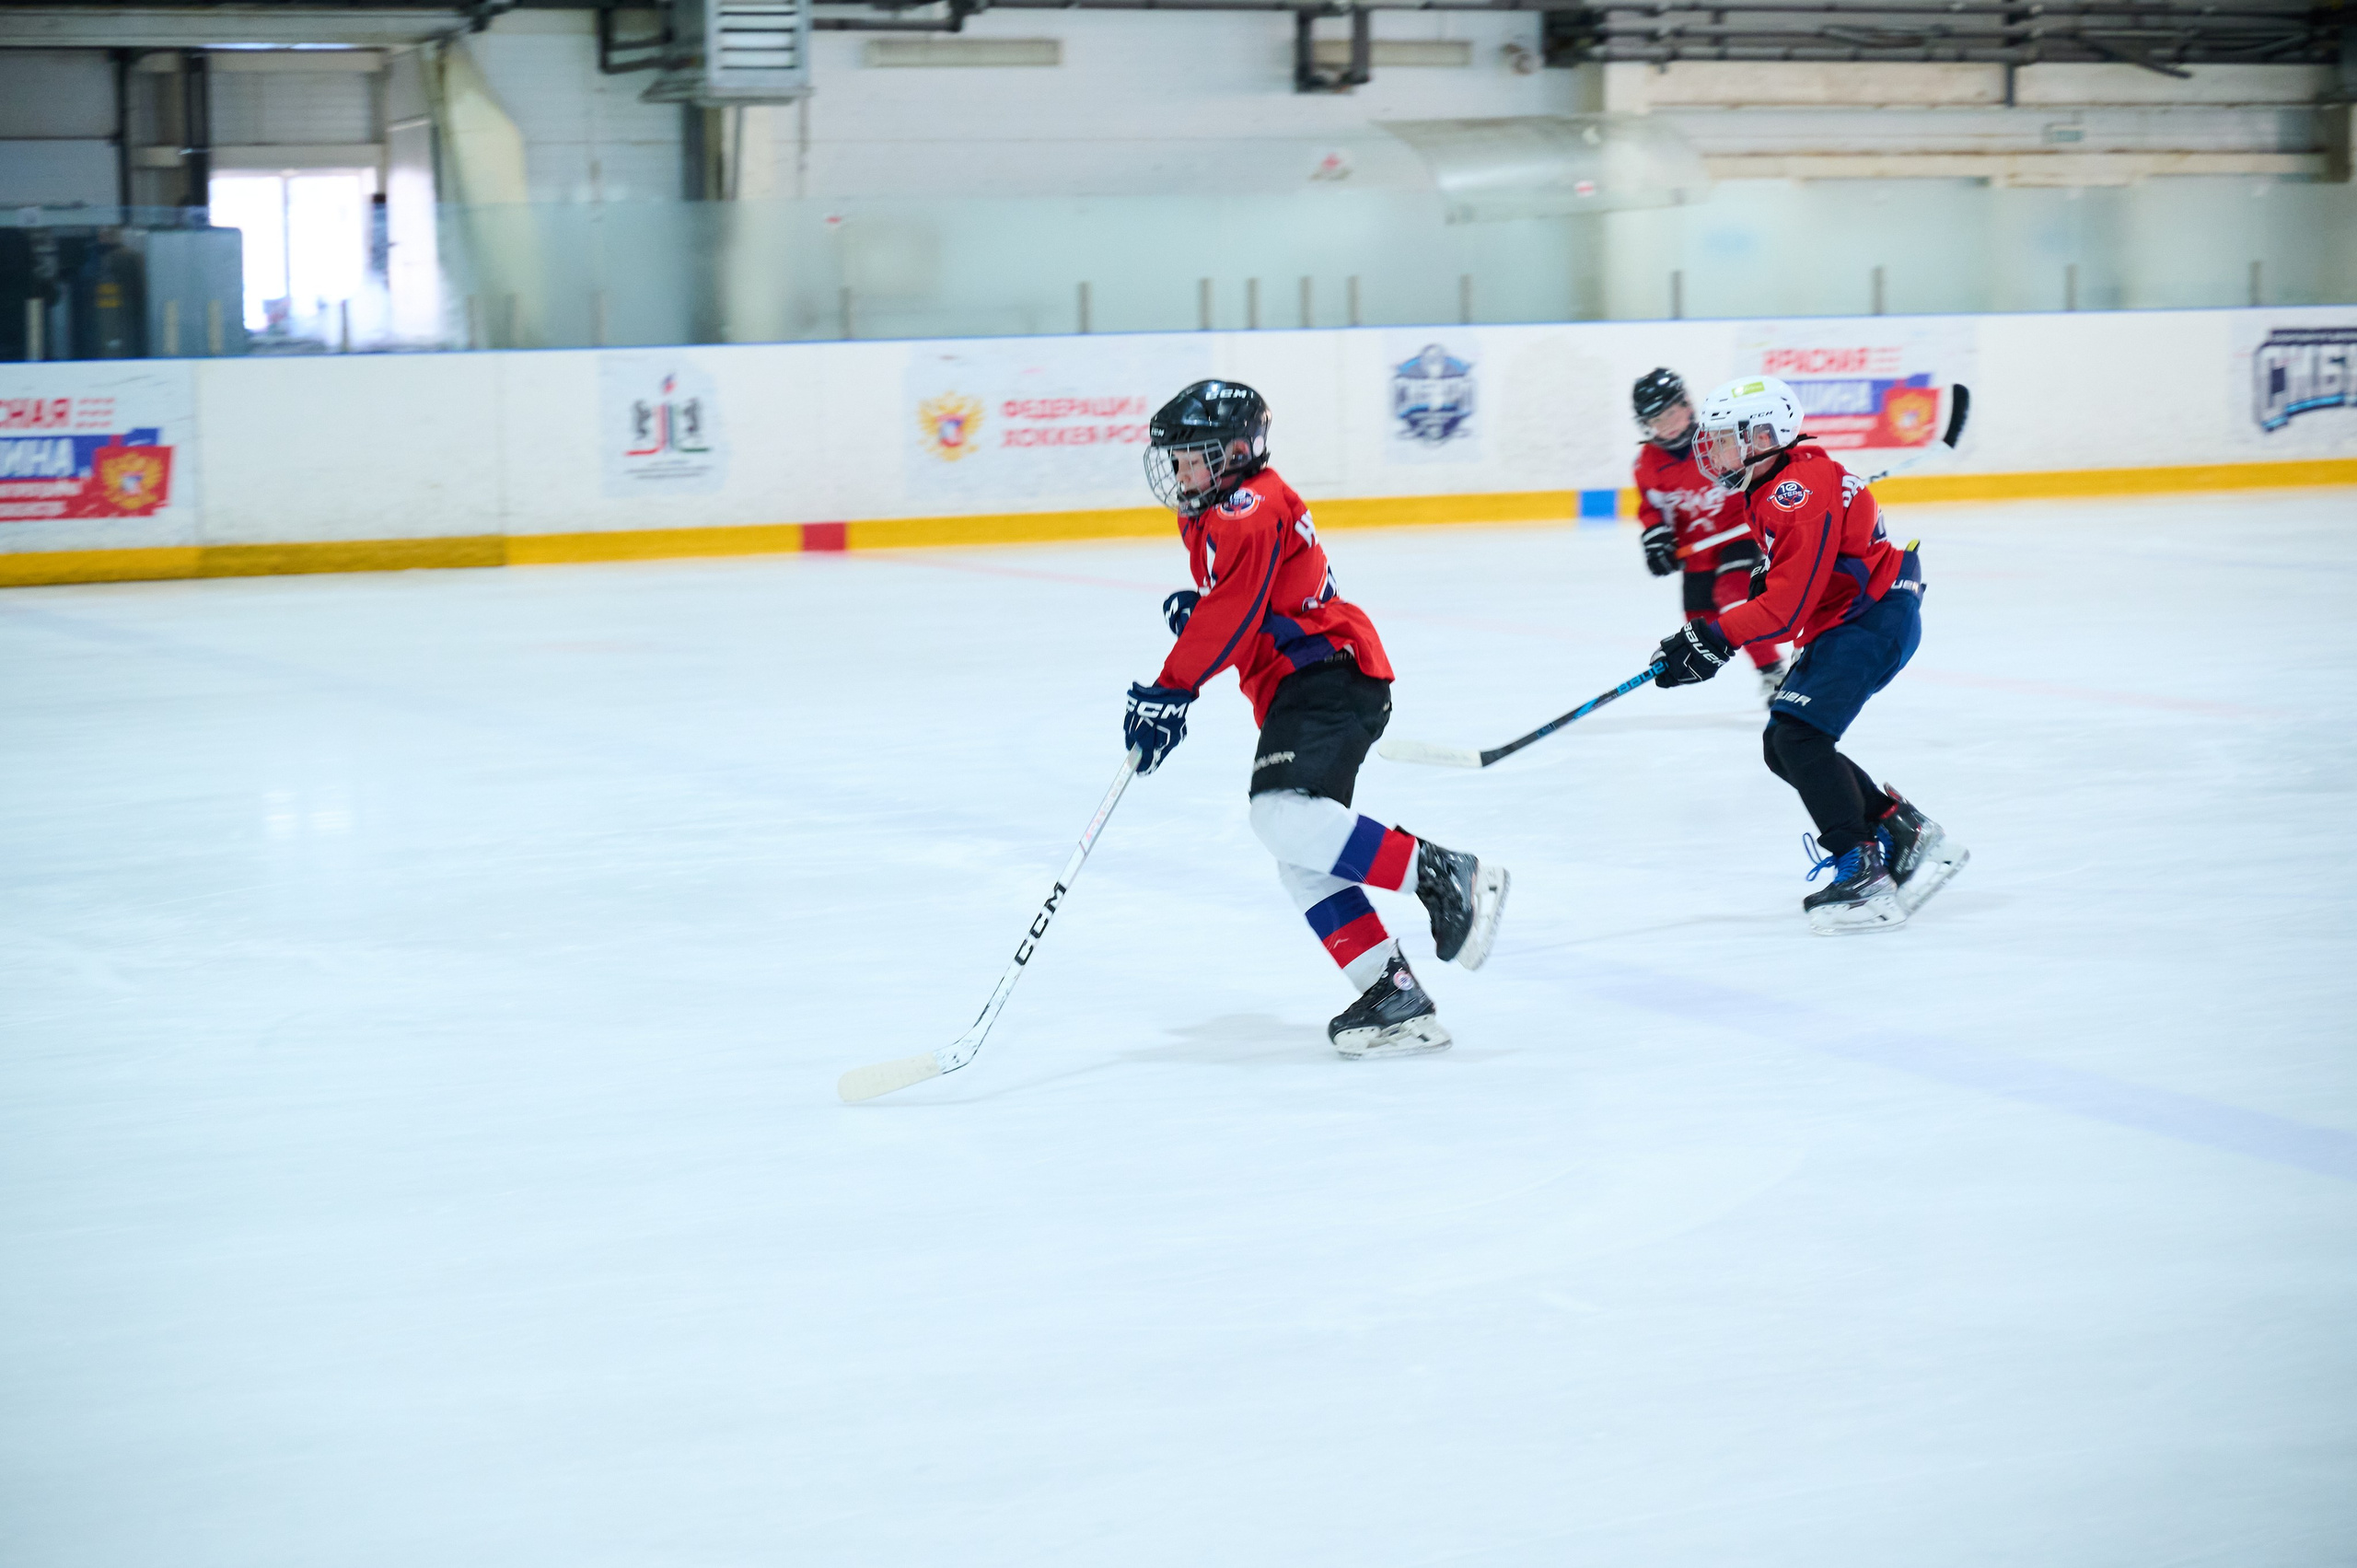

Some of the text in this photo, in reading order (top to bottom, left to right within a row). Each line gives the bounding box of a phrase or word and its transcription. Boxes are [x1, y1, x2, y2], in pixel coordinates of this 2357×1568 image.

[1749, 410, 1773, 420] CCM
[1126, 694, 1188, 719] CCM
[1015, 881, 1067, 966] CCM
